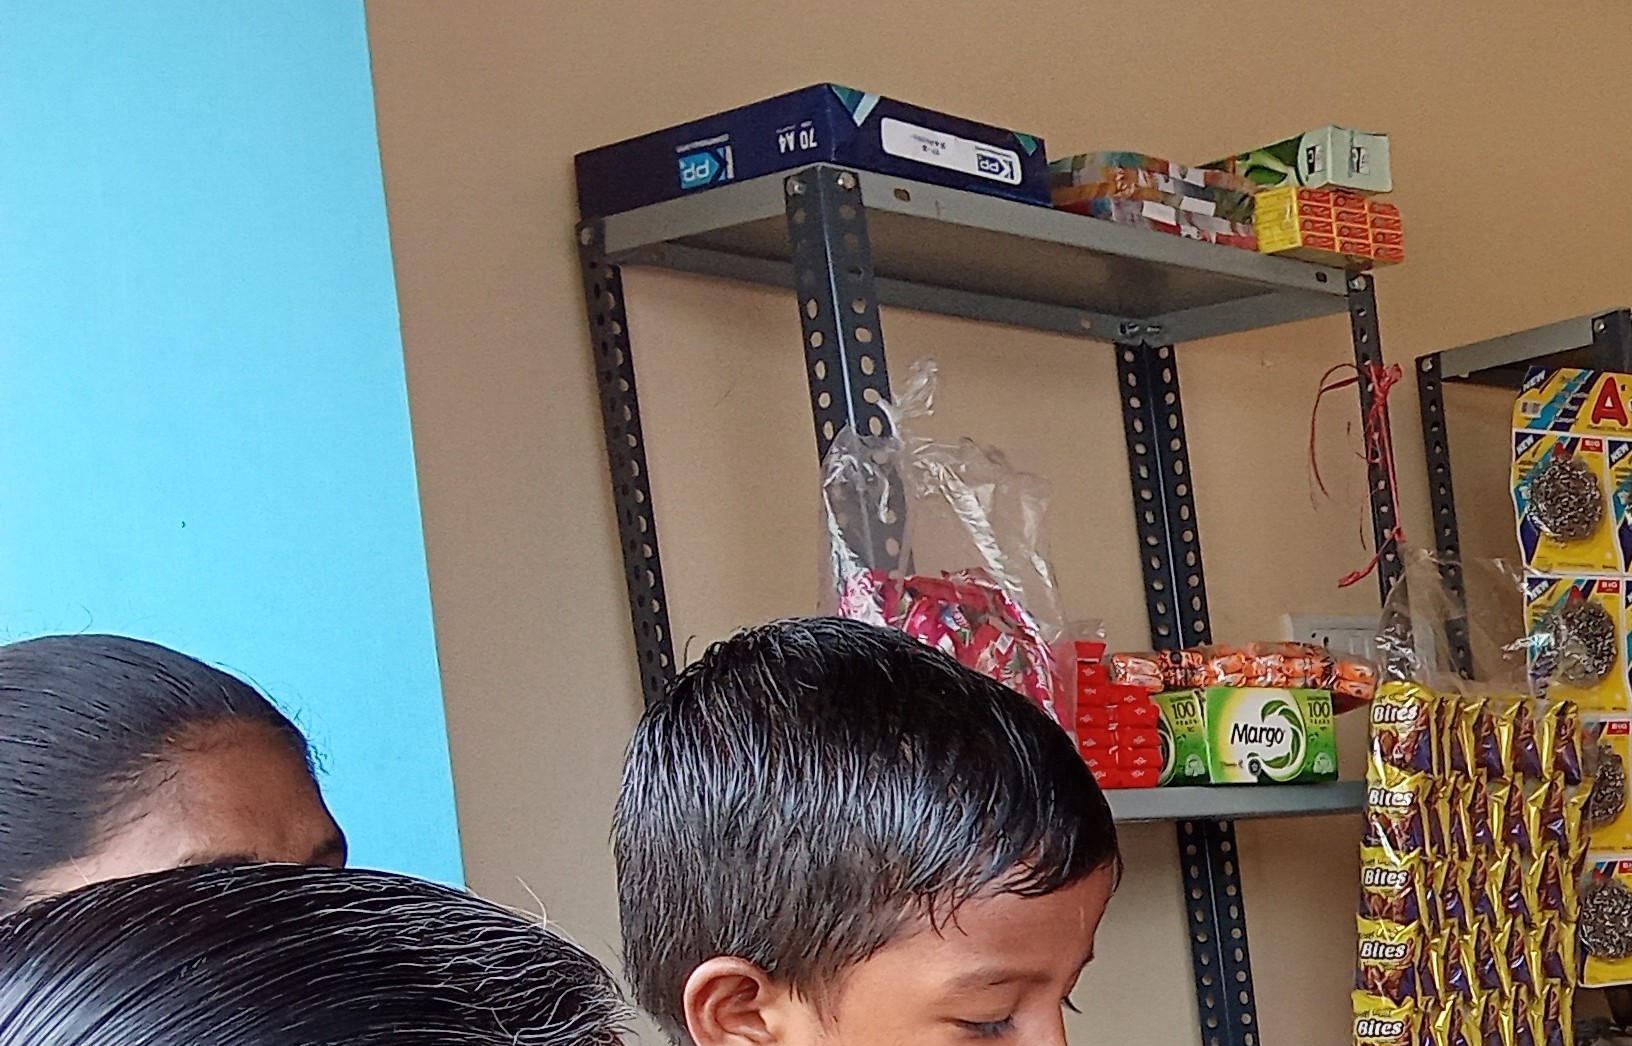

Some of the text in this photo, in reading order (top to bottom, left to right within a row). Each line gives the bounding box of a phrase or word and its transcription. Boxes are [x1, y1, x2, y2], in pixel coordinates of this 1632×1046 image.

[1172, 701, 1196, 720] 100
[1308, 701, 1331, 719] 100
[1373, 704, 1419, 725] Bites
[1230, 723, 1286, 748] Margo
[1369, 788, 1414, 807] Bites
[1364, 868, 1408, 888] Bites
[1361, 941, 1406, 960] Bites
[1357, 1019, 1404, 1038] Bites
